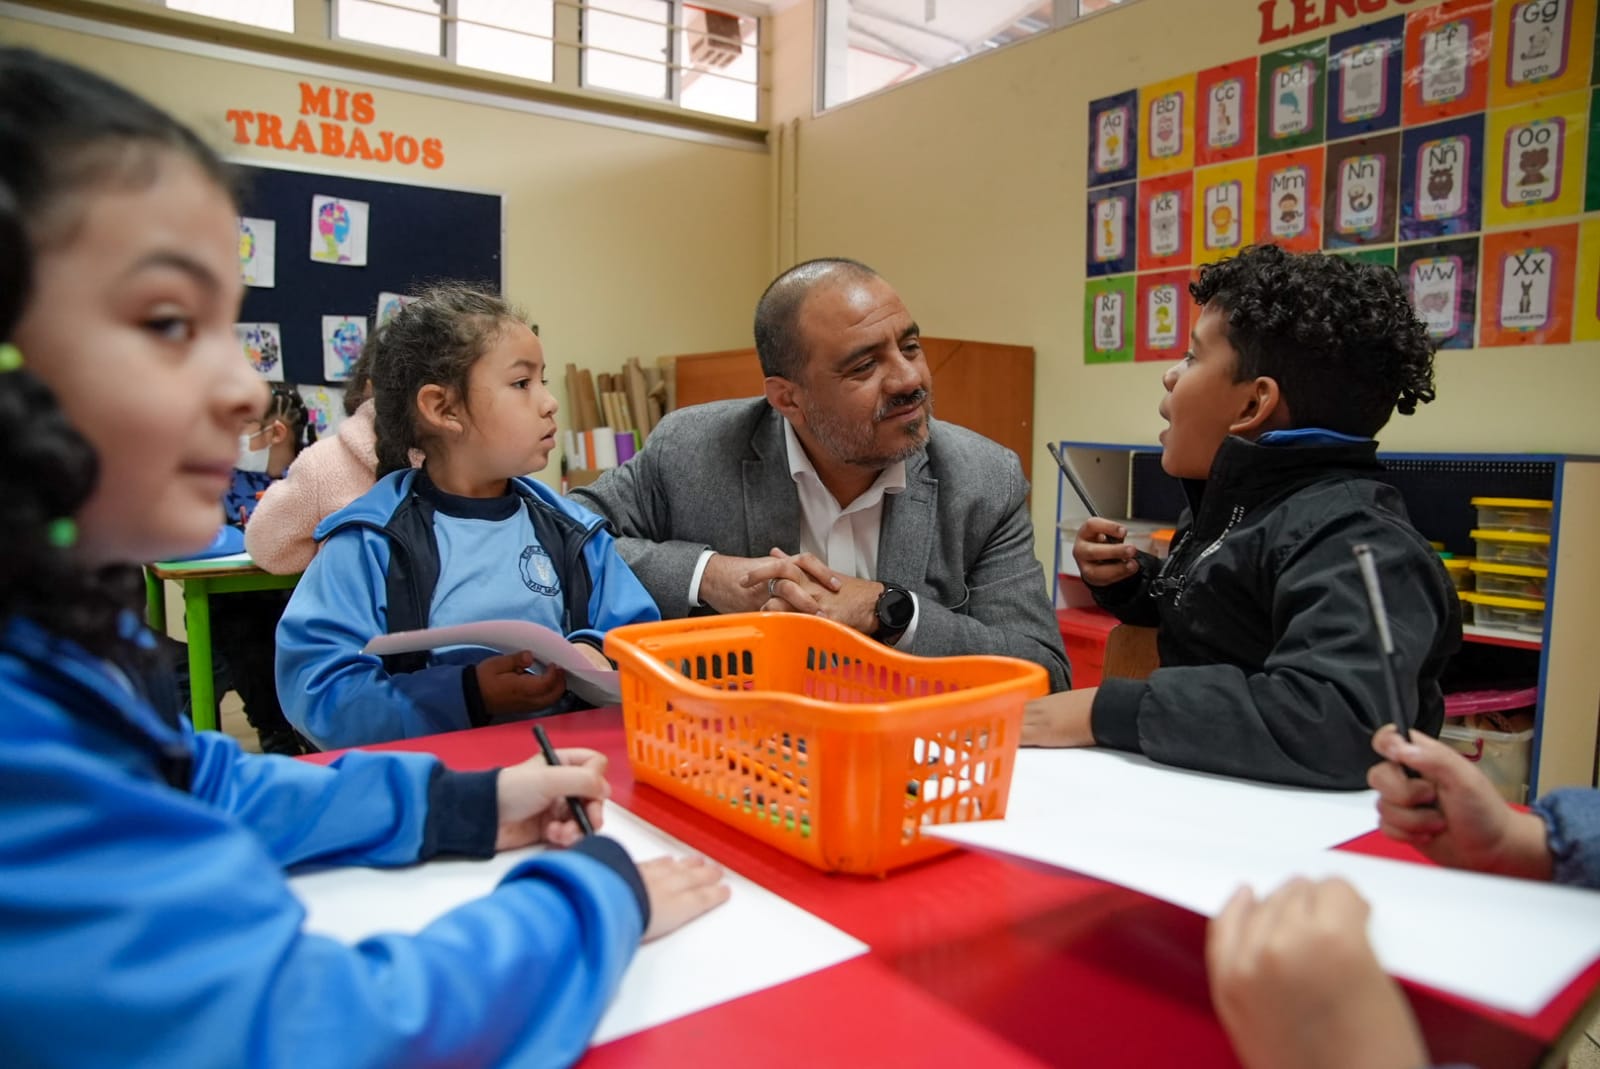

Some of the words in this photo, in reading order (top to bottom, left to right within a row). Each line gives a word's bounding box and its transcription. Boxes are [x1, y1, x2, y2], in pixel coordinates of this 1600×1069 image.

[1523, 1, 1558, 23] Gg
[1522, 64, 1549, 80] gato
[1214, 85, 1234, 102] Cc
[298, 81, 376, 124] MIS
[1156, 99, 1176, 116] Bb
[1103, 114, 1121, 130] Aa
[226, 109, 445, 170] TRABAJOS
[1517, 127, 1551, 148] Oo
[1348, 161, 1375, 180] Nn
[1272, 174, 1304, 192] Mm
[1416, 264, 1455, 281] Ww
[1513, 255, 1544, 277] Xx
[1101, 295, 1117, 311] Rr
[1153, 289, 1172, 305] Ss
